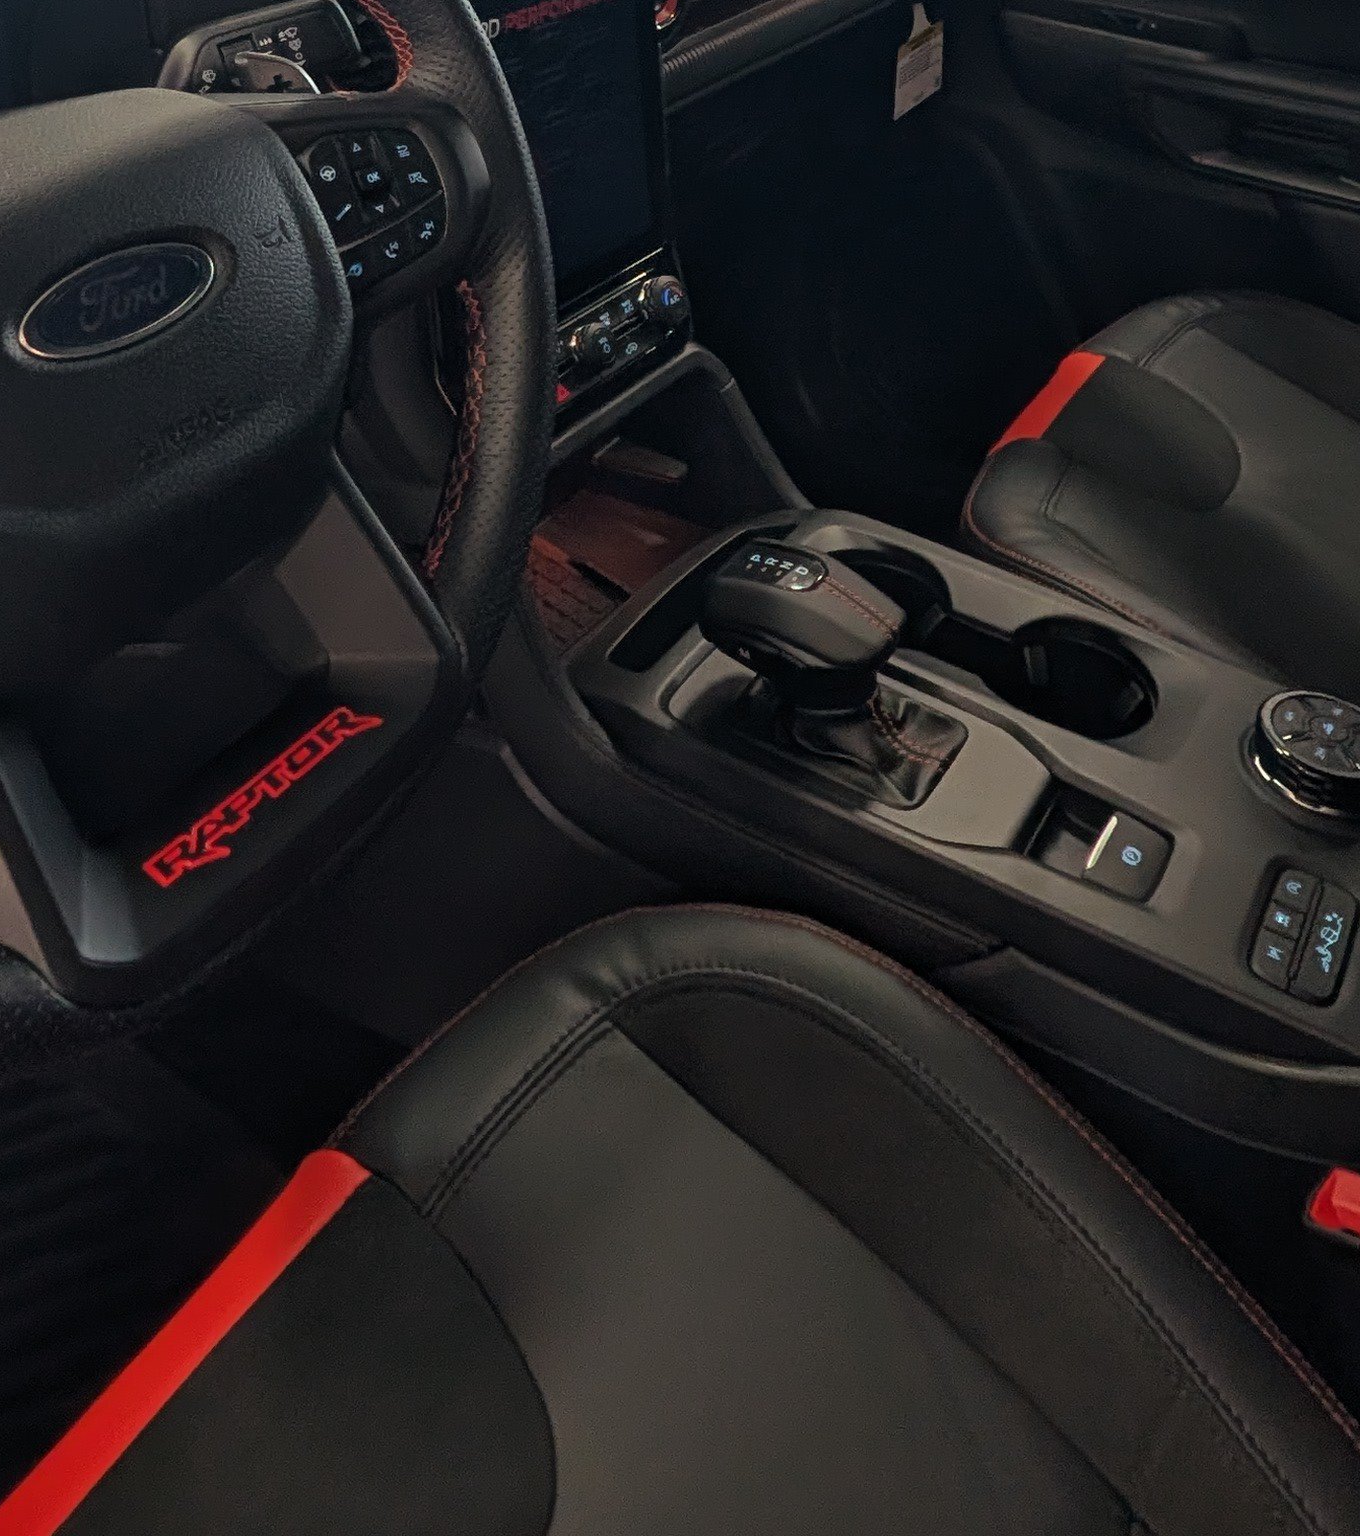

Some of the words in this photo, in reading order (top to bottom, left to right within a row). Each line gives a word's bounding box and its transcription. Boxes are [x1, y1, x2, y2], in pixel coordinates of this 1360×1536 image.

[366, 171, 381, 184] OK
[79, 263, 167, 332] Ford
[142, 706, 384, 888] RAPTOR
